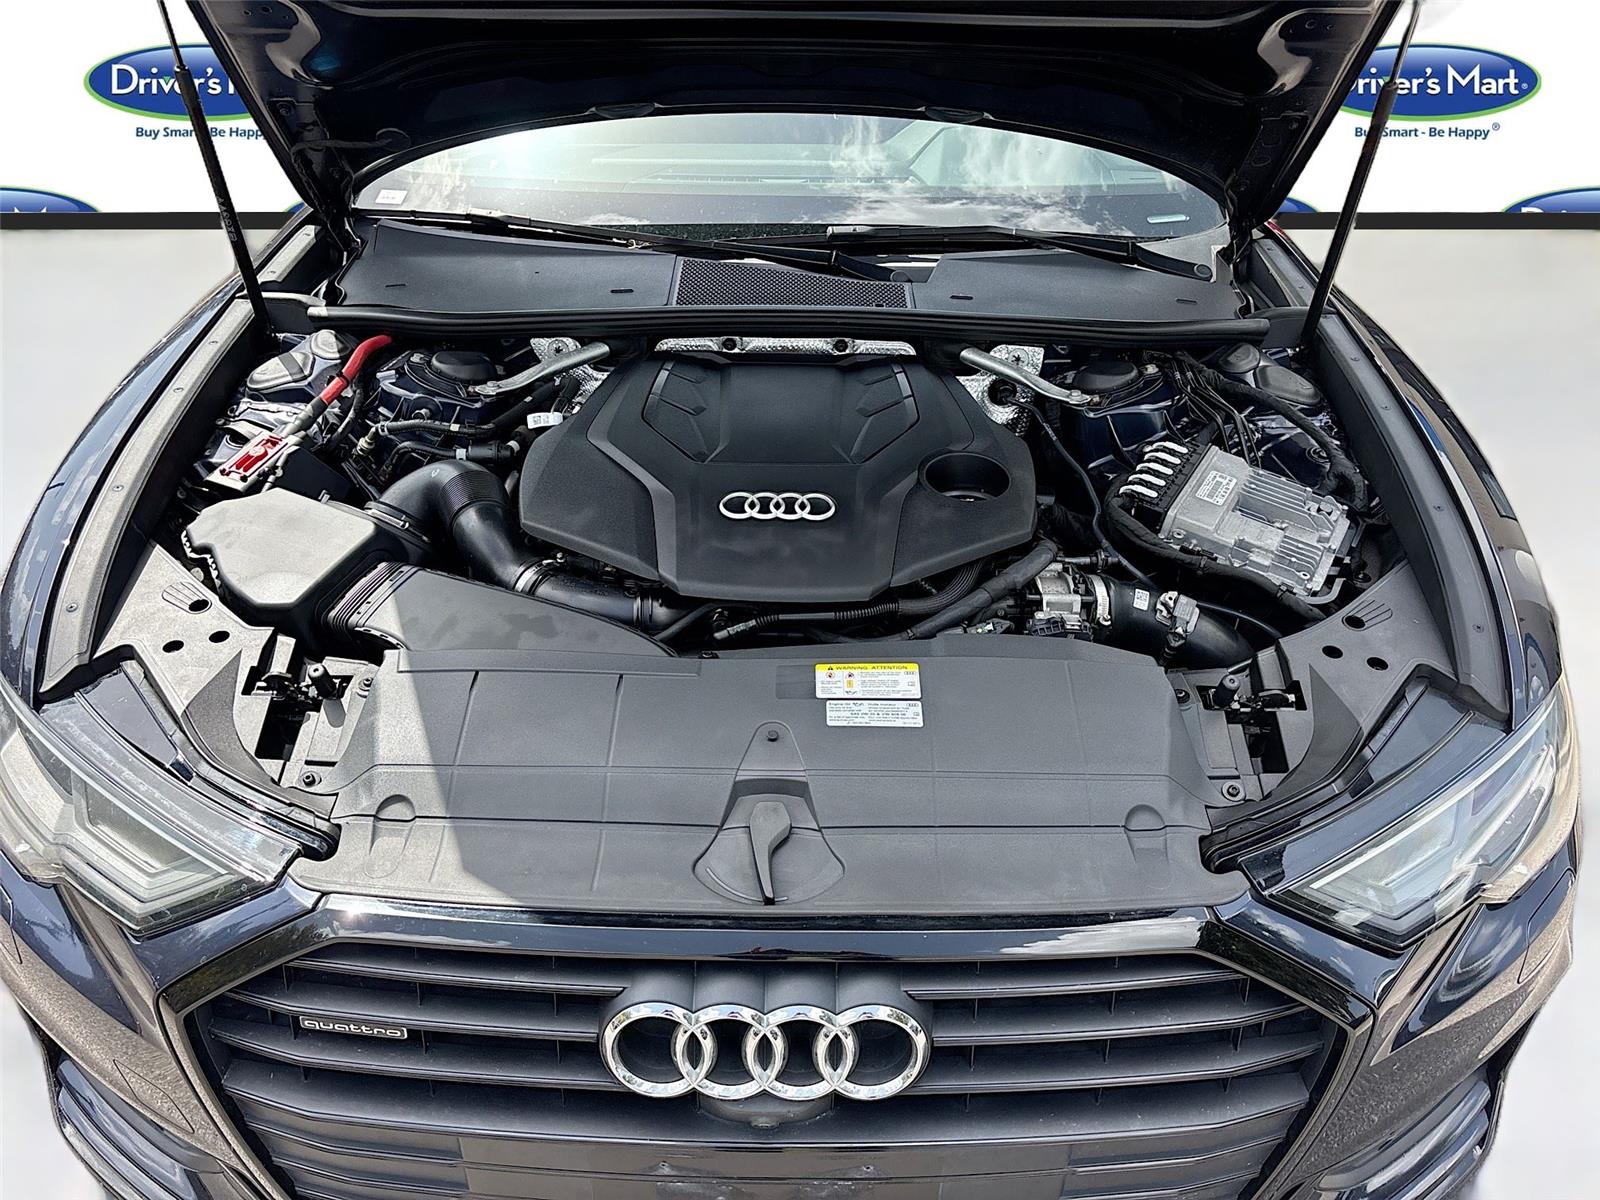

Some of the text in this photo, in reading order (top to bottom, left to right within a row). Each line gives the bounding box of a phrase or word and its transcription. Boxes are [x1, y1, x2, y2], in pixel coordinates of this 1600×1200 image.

[1350, 63, 1519, 95] rier's Mart
[136, 127, 266, 140] Buy Smar Be Happ
[1382, 127, 1418, 137] Smart
[1428, 127, 1445, 137] Be
[1448, 127, 1490, 140] Happy
[304, 1020, 401, 1037] quattro
